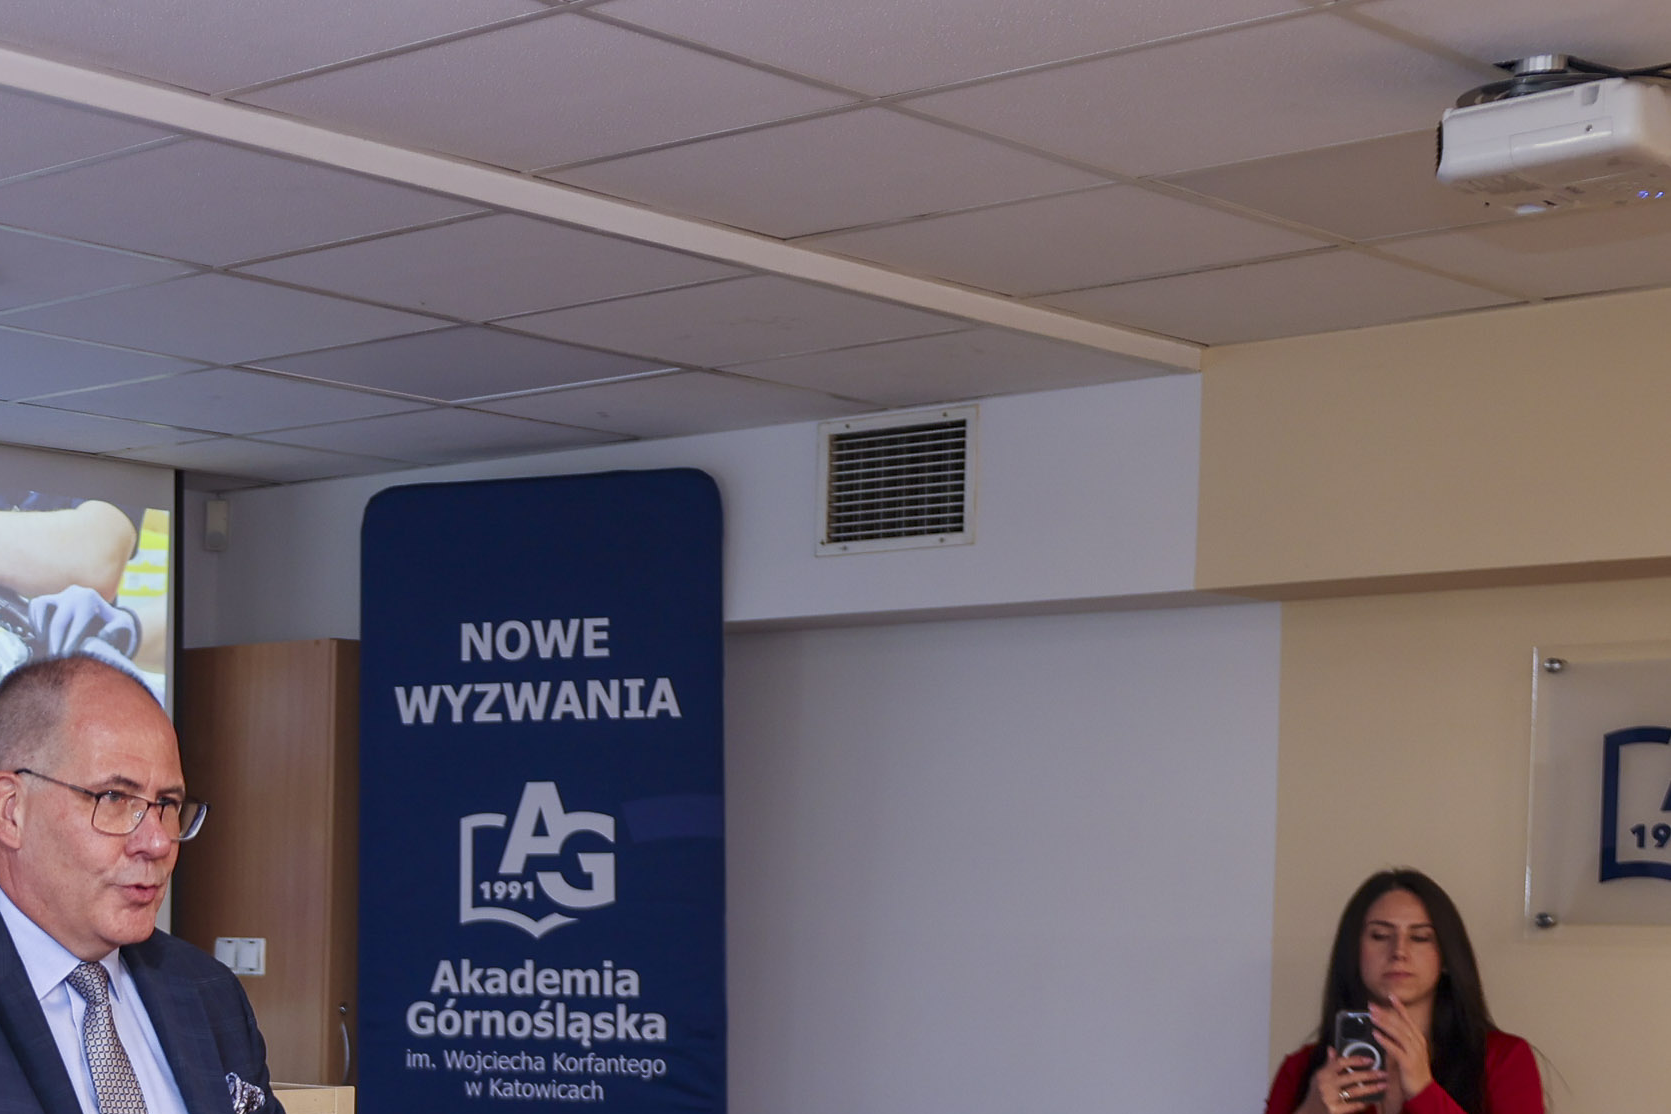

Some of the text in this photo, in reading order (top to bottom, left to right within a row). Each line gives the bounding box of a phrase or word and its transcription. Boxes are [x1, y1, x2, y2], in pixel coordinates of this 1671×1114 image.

[460, 617, 610, 662] NOWE
[394, 677, 682, 725] WYZWANIA
[479, 880, 535, 900] 1991
[431, 958, 640, 998] Akademia
[406, 998, 668, 1048] Górnośląska
[405, 1049, 667, 1079] im. Wojciecha Korfantego
[464, 1078, 605, 1101] w Katowicach
